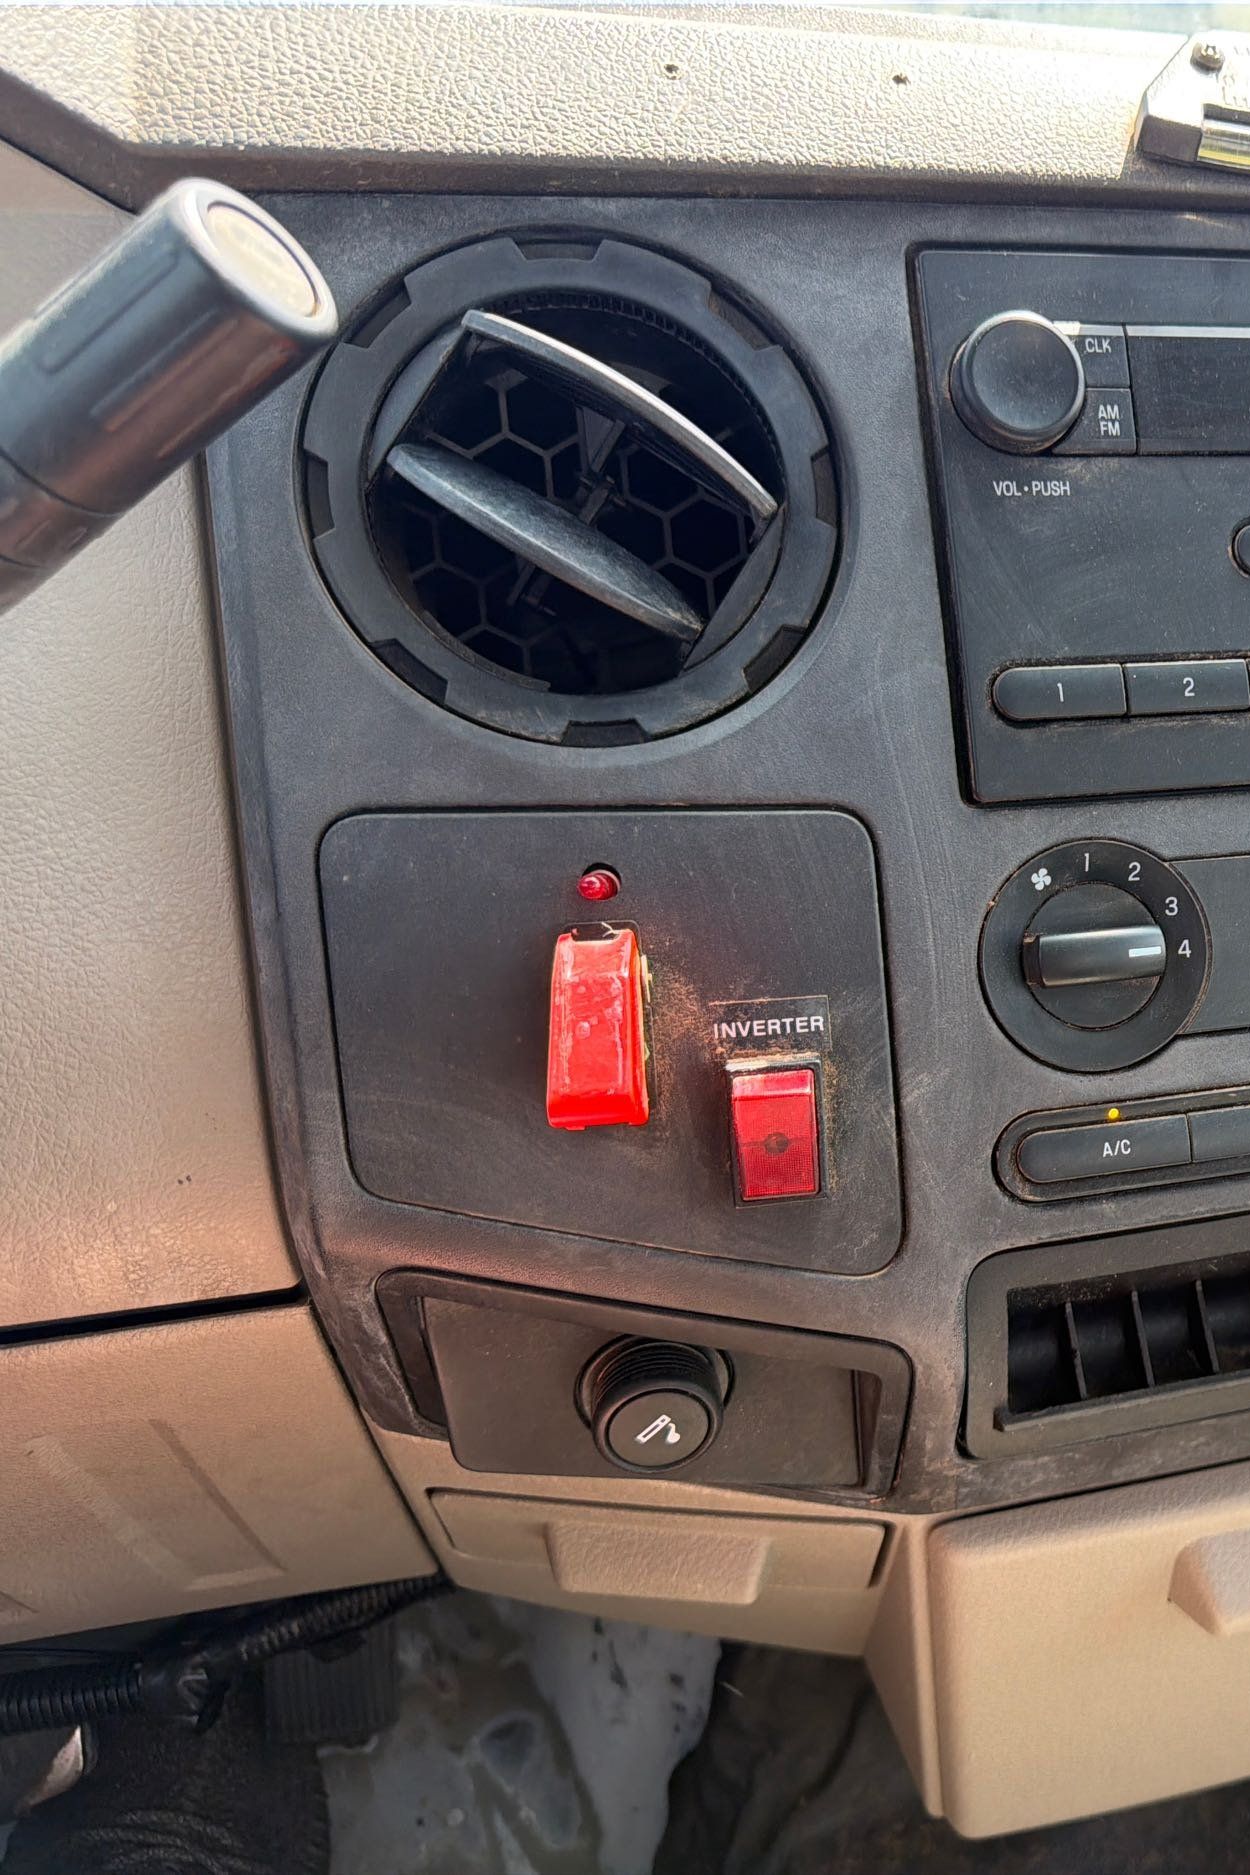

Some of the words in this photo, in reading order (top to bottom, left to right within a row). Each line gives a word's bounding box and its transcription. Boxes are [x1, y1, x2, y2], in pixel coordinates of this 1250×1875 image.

[1085, 337, 1112, 353] CLK
[1098, 404, 1120, 420] AM
[1099, 421, 1121, 436] FM
[1057, 683, 1064, 702] 1
[1183, 678, 1195, 697] 2
[1084, 853, 1090, 872] 1
[1128, 861, 1141, 882] 2
[1165, 896, 1178, 916] 3
[1178, 939, 1192, 958] 4
[714, 1015, 825, 1039] INVERTER
[1102, 1139, 1132, 1159] A/C
